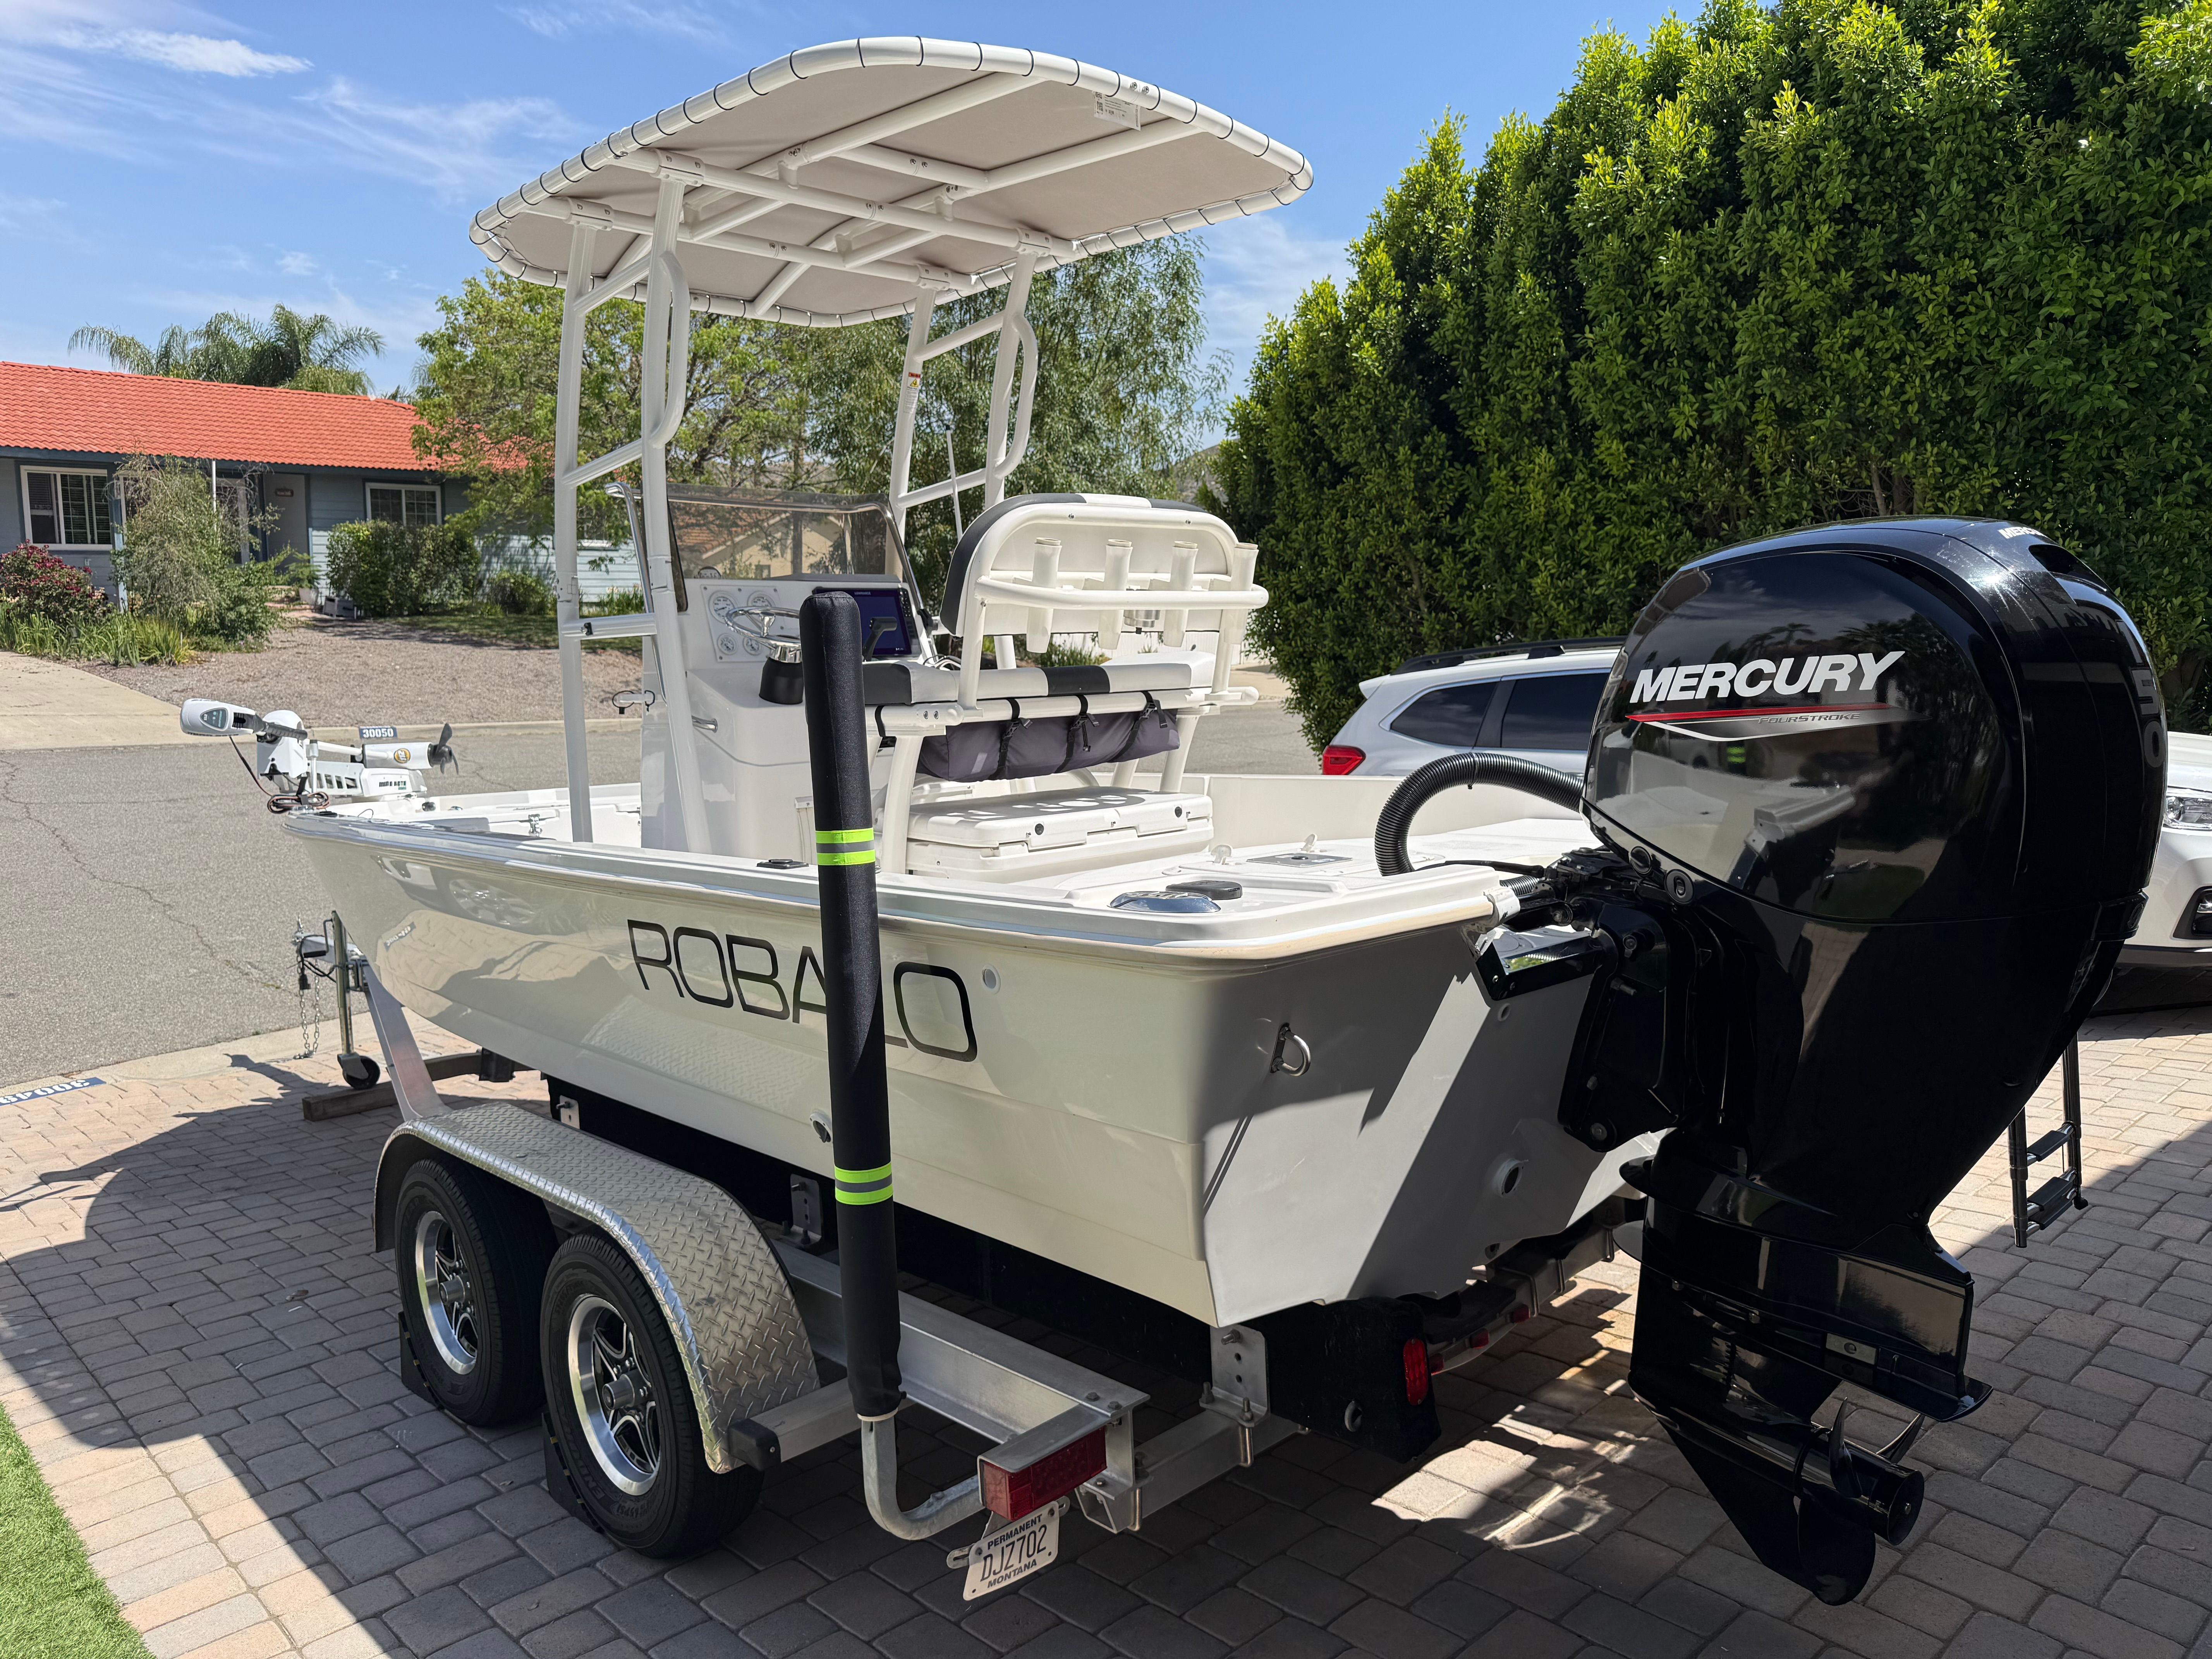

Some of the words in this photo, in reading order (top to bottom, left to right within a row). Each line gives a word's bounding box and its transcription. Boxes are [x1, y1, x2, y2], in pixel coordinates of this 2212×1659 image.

[1998, 527, 2048, 539] MERCU
[1630, 651, 1905, 703] MERCURY
[362, 728, 394, 738] 30050
[627, 919, 978, 1063] ROBAO
[988, 1513, 1043, 1550] PERMANENT
[980, 1524, 1047, 1582] DJZ702
[988, 1559, 1037, 1589] MONTANA
